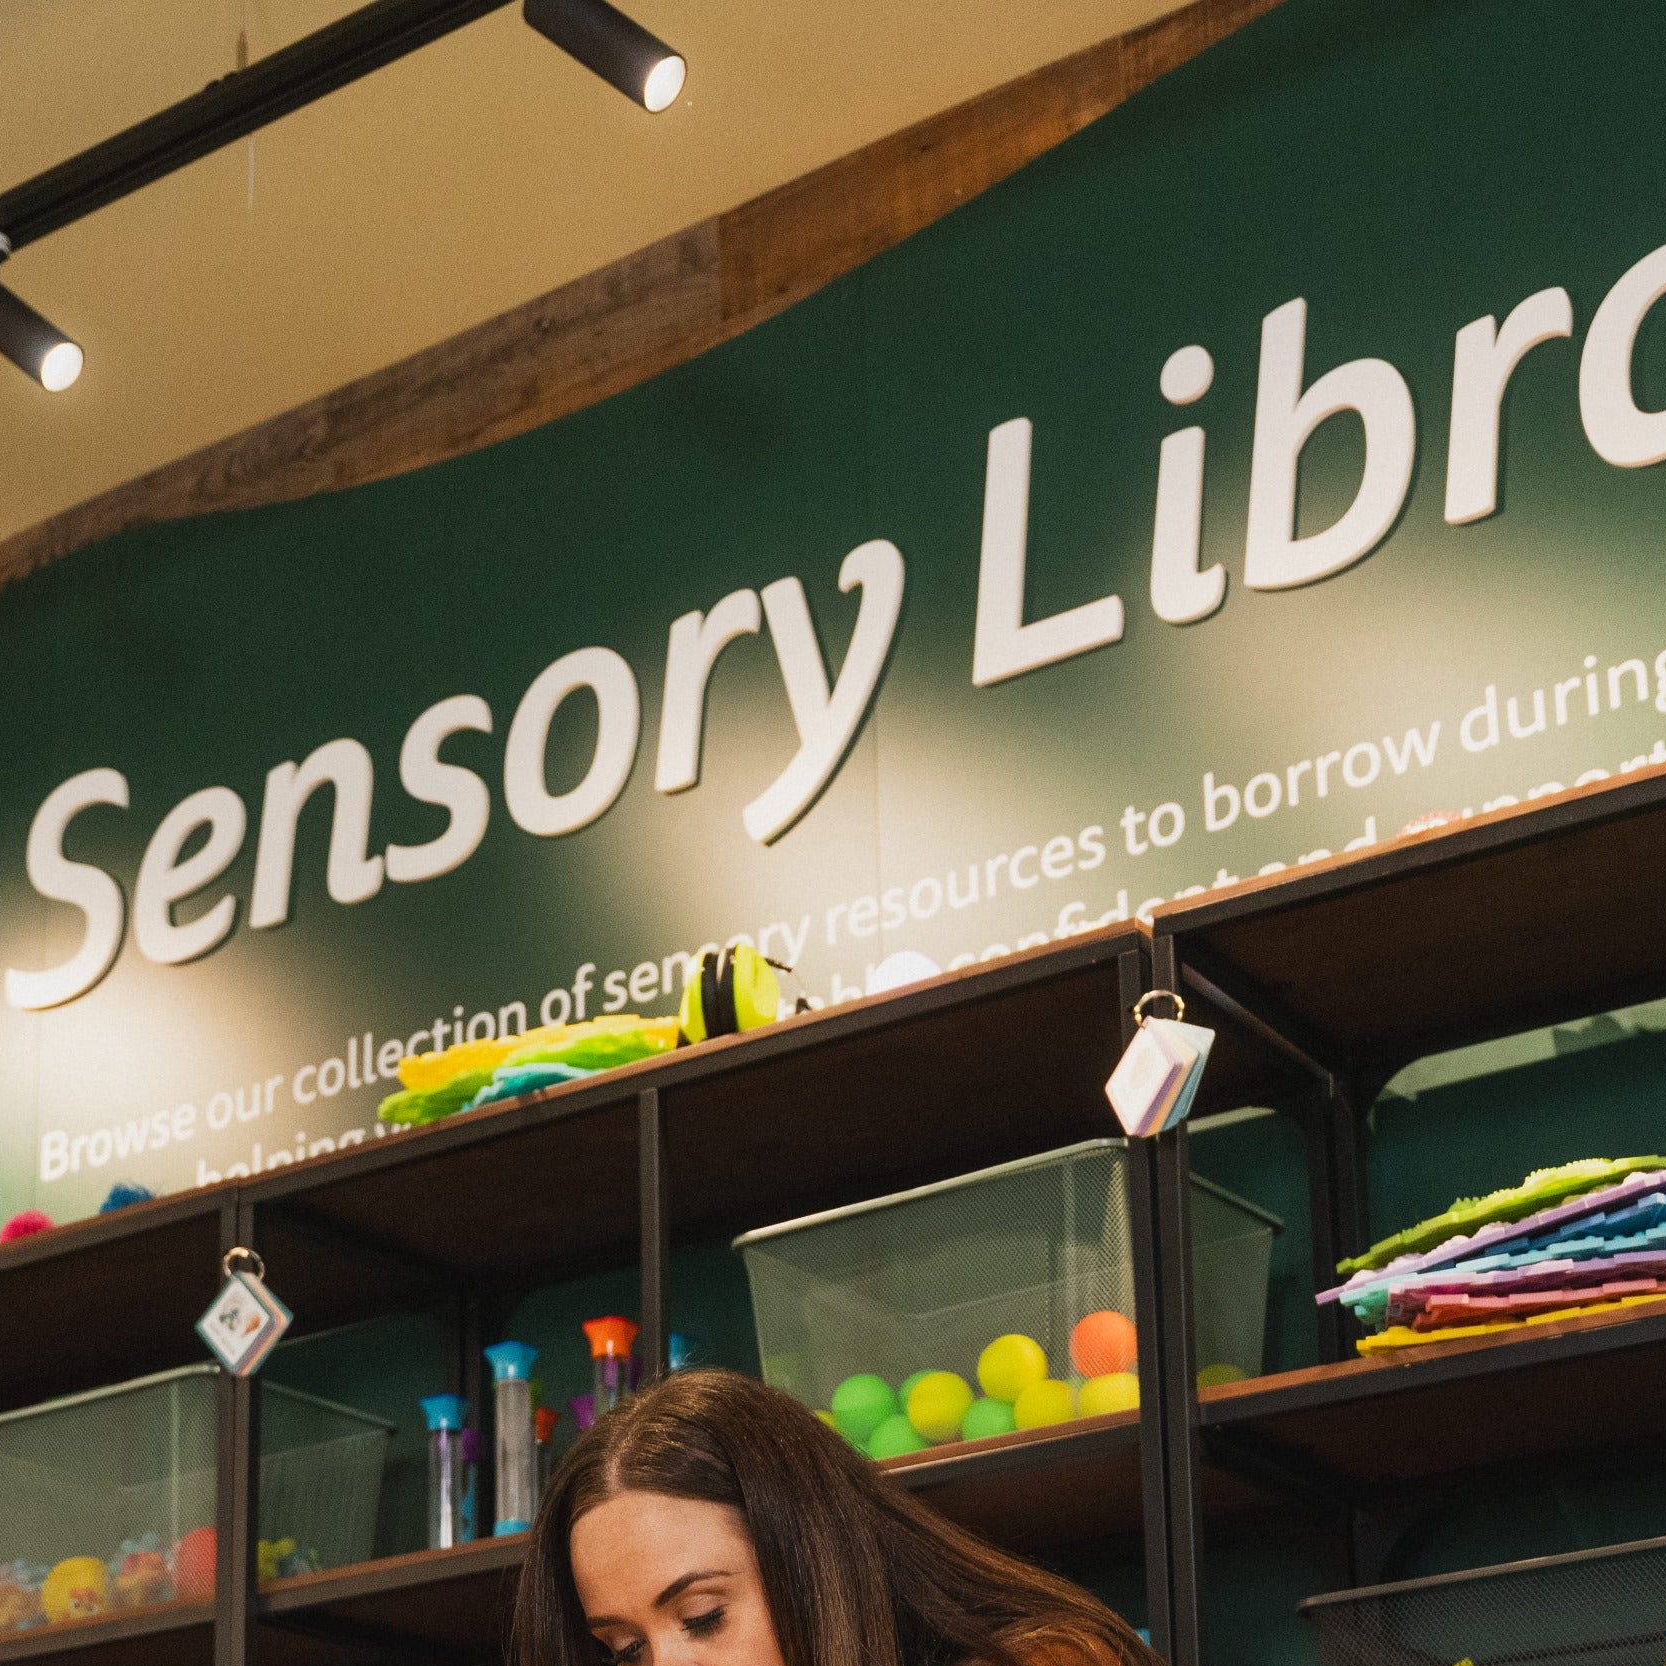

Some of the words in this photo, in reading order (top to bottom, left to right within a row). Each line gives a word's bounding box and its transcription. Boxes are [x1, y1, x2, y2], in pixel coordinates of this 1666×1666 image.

[5, 539, 905, 1010] Sensory
[39, 1103, 197, 1182] Browse
[205, 1074, 284, 1130] our
[292, 1001, 527, 1104] collection
[540, 961, 596, 1028] of
[602, 915, 812, 1013] senry
[825, 824, 1106, 946] resources
[1120, 801, 1186, 856] to
[1203, 720, 1441, 832] borrow
